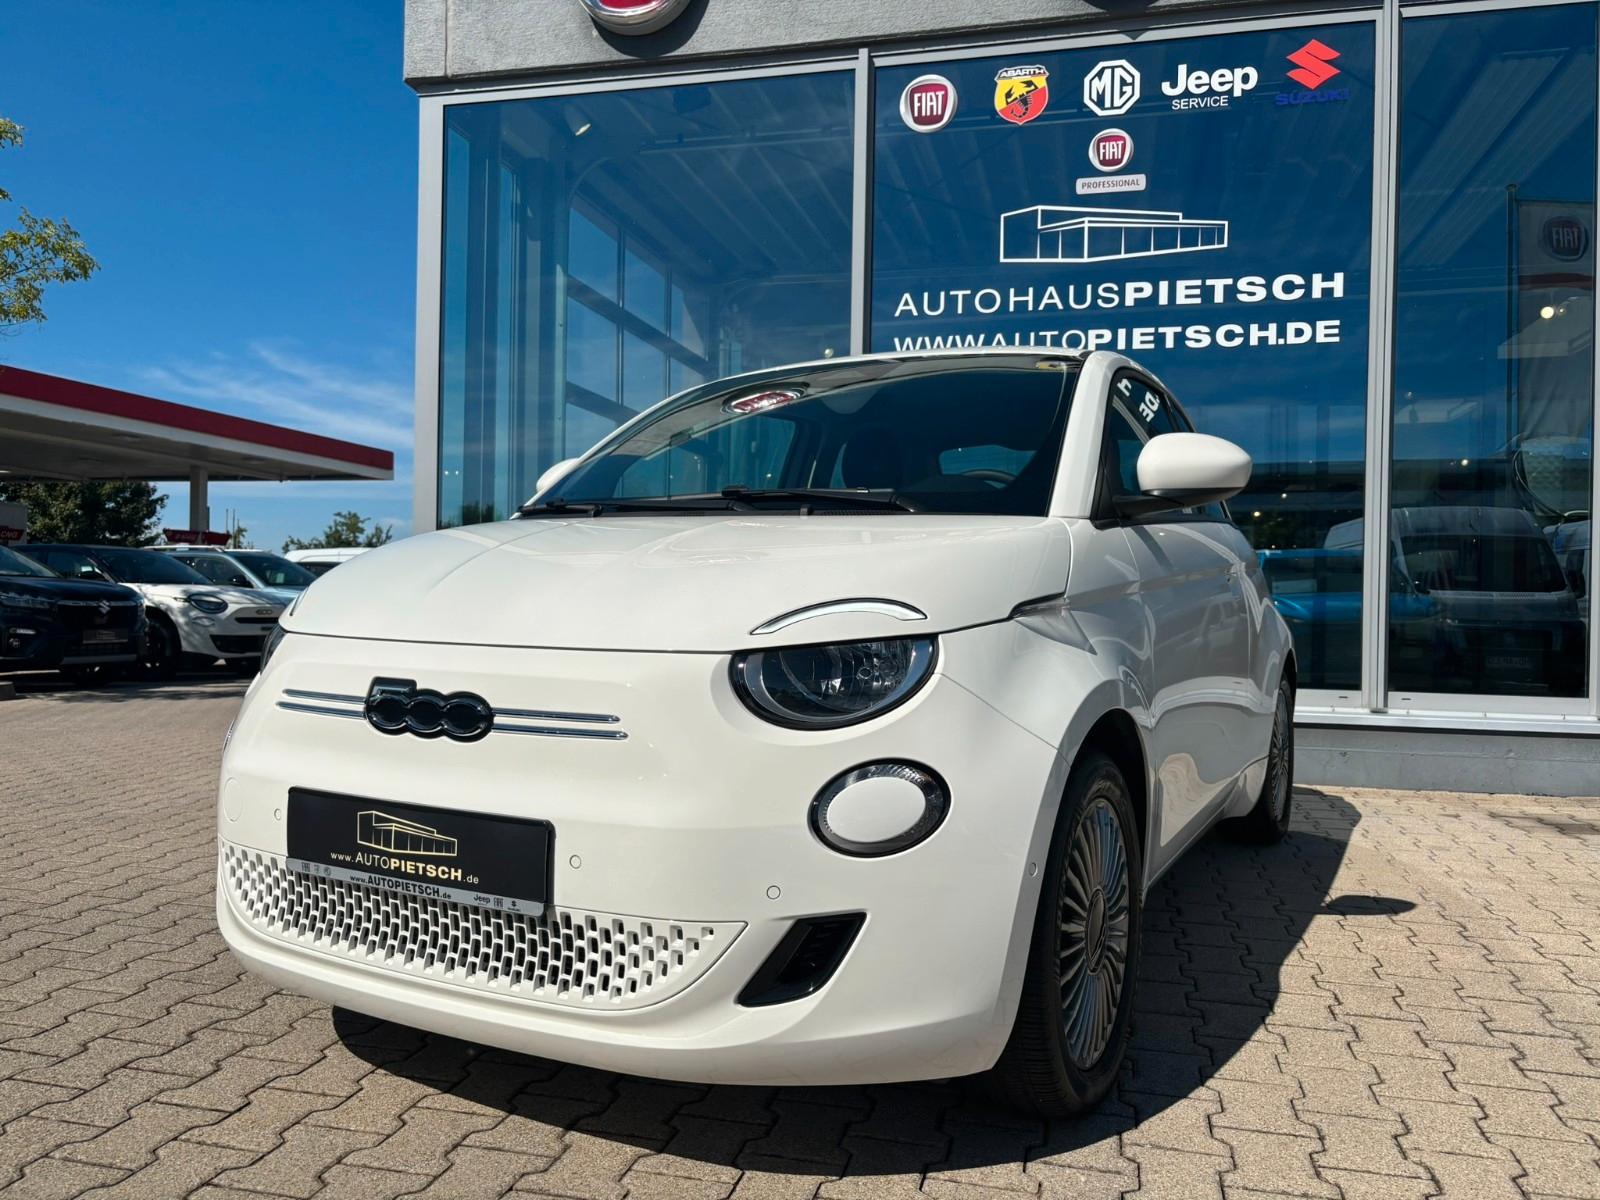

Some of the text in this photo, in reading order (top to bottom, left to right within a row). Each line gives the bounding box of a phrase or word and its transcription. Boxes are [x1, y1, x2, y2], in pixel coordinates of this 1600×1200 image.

[999, 68, 1044, 78] ABARTH
[1161, 63, 1259, 97] Jeep
[1090, 67, 1134, 109] MG
[1274, 88, 1350, 106] SUZUKI
[913, 91, 945, 118] FIAT
[1171, 94, 1229, 110] SERVICE
[1099, 140, 1125, 161] FIAT
[1081, 178, 1141, 191] PROFESSIONAL
[1552, 226, 1579, 249] FIAT
[894, 271, 1345, 317] AUTOHAUSPIETSCH
[893, 319, 1341, 352] WWWAUTOPIETSCH.DE
[365, 676, 494, 743] 500
[330, 851, 480, 885] www.AUTOPIETSCH.de
[349, 875, 452, 900] www.AUTOPIETSCH.de
[473, 893, 491, 904] Jeep
